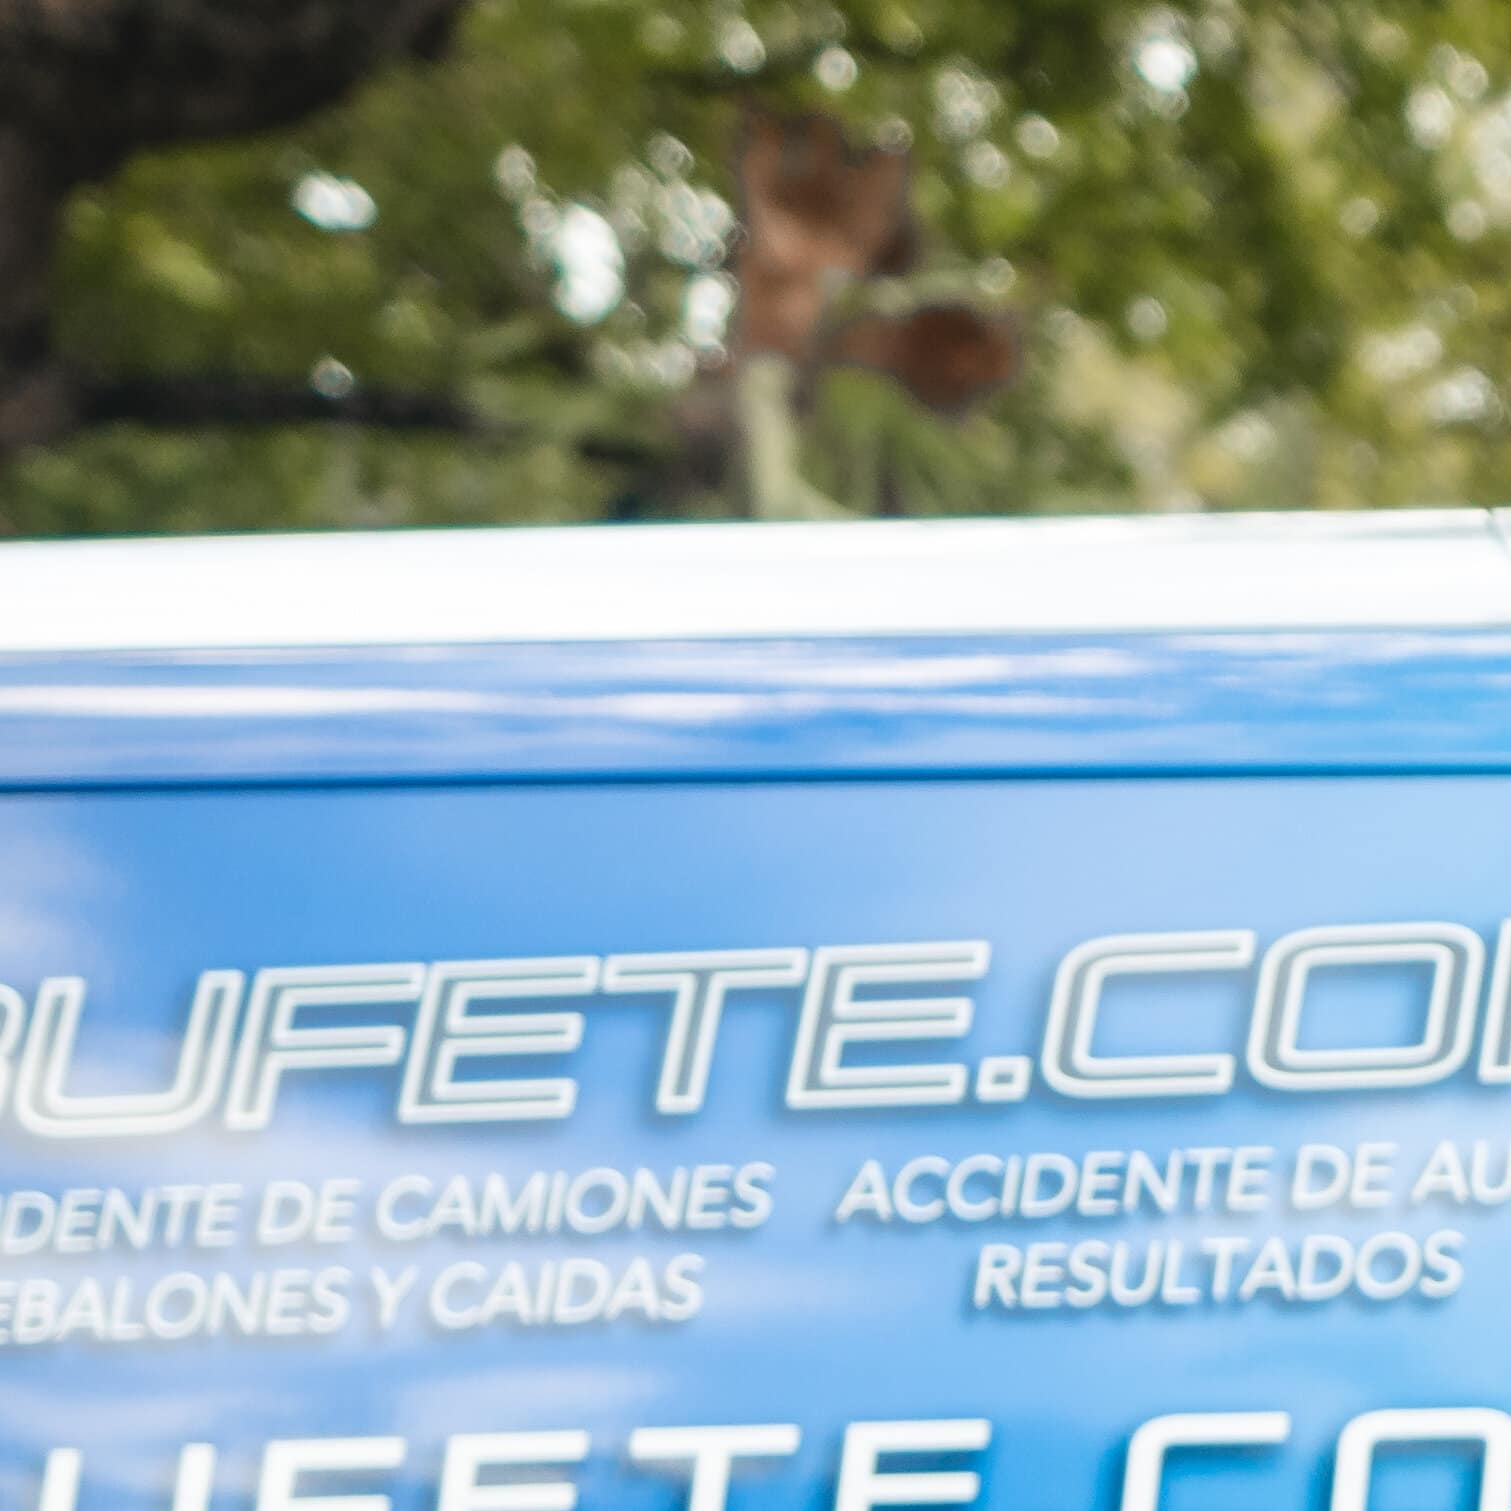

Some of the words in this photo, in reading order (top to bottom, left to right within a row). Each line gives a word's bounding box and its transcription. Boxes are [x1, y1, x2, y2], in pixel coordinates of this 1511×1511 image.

[0, 1183, 243, 1255] DENTE
[258, 1178, 363, 1245] DE
[375, 1161, 776, 1241] CAMIONES
[836, 1146, 1274, 1224] ACCIDENTE
[1290, 1140, 1400, 1212] DE
[371, 1264, 419, 1329] Y
[428, 1252, 706, 1330] CAIDAS
[972, 1230, 1464, 1311] RESULTADOS
